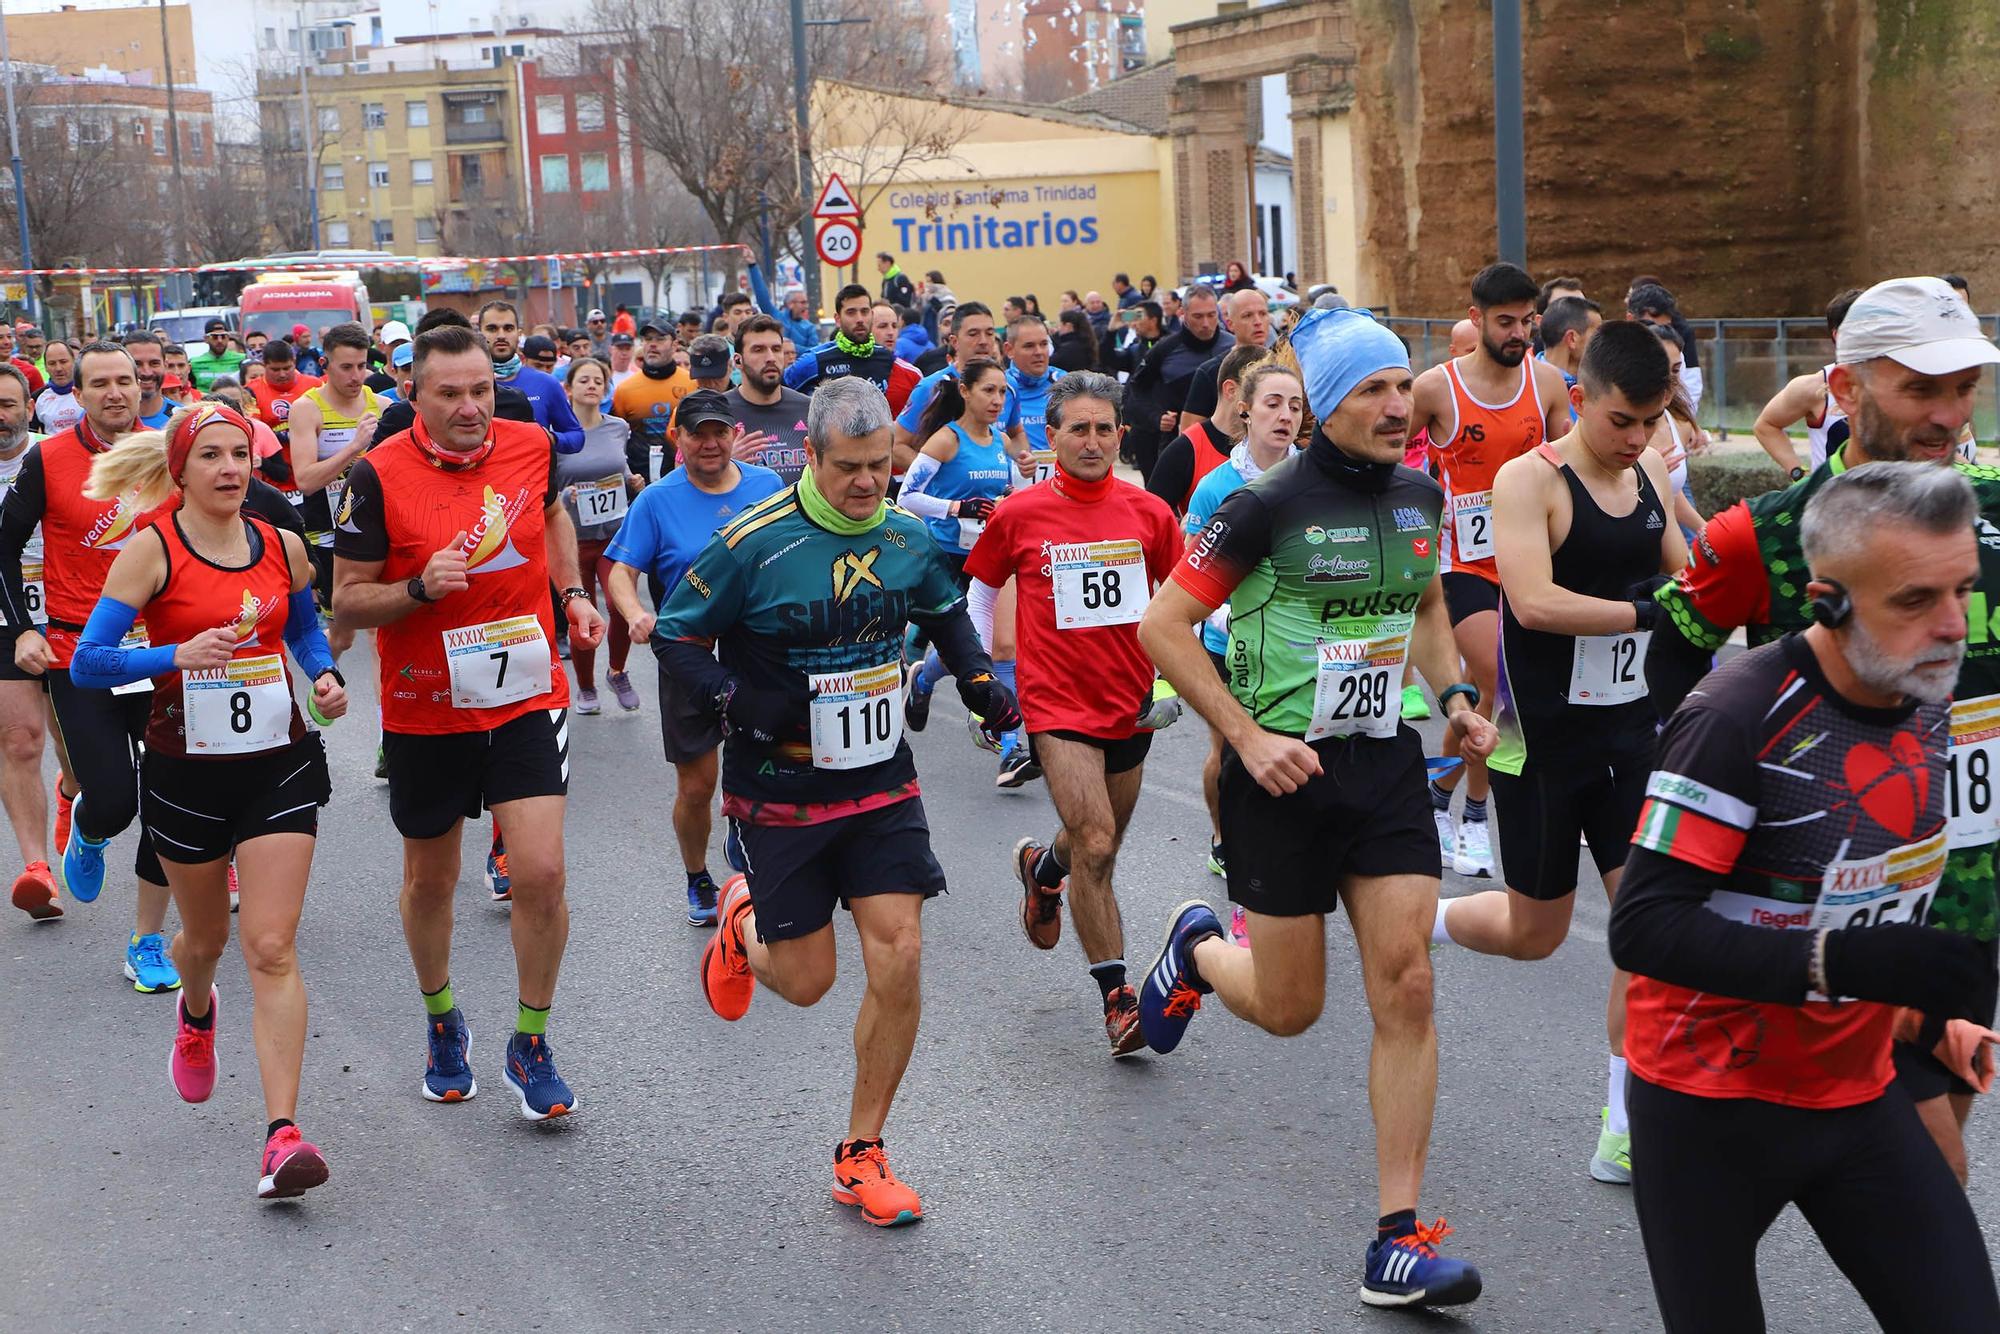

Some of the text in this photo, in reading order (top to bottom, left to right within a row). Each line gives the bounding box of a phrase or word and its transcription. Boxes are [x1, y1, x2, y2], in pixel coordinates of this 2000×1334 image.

[889, 192, 949, 209] Colegio
[1034, 184, 1096, 202] Trinidad
[827, 236, 852, 251] 20
[892, 211, 1099, 252] Trinitarios
[1020, 416, 1047, 425] TASIE
[589, 490, 616, 515] 127
[1457, 494, 1485, 508] XXXIX
[884, 527, 906, 548] SIG
[1187, 520, 1224, 570] pulso
[1055, 547, 1090, 562] XXXIX
[1082, 570, 1121, 609] 58
[1320, 591, 1419, 624] pulso
[448, 628, 485, 648] XXXIX
[1321, 625, 1350, 635] TRAIL
[1354, 624, 1395, 633] RUNNING
[1233, 640, 1250, 688] pulso
[1323, 644, 1367, 661] XXXIX
[1611, 638, 1637, 684] 12
[490, 650, 509, 689] 7
[815, 677, 853, 694] XXXIX
[1330, 670, 1389, 720] 289
[229, 691, 251, 734] 8
[836, 697, 891, 749] 110
